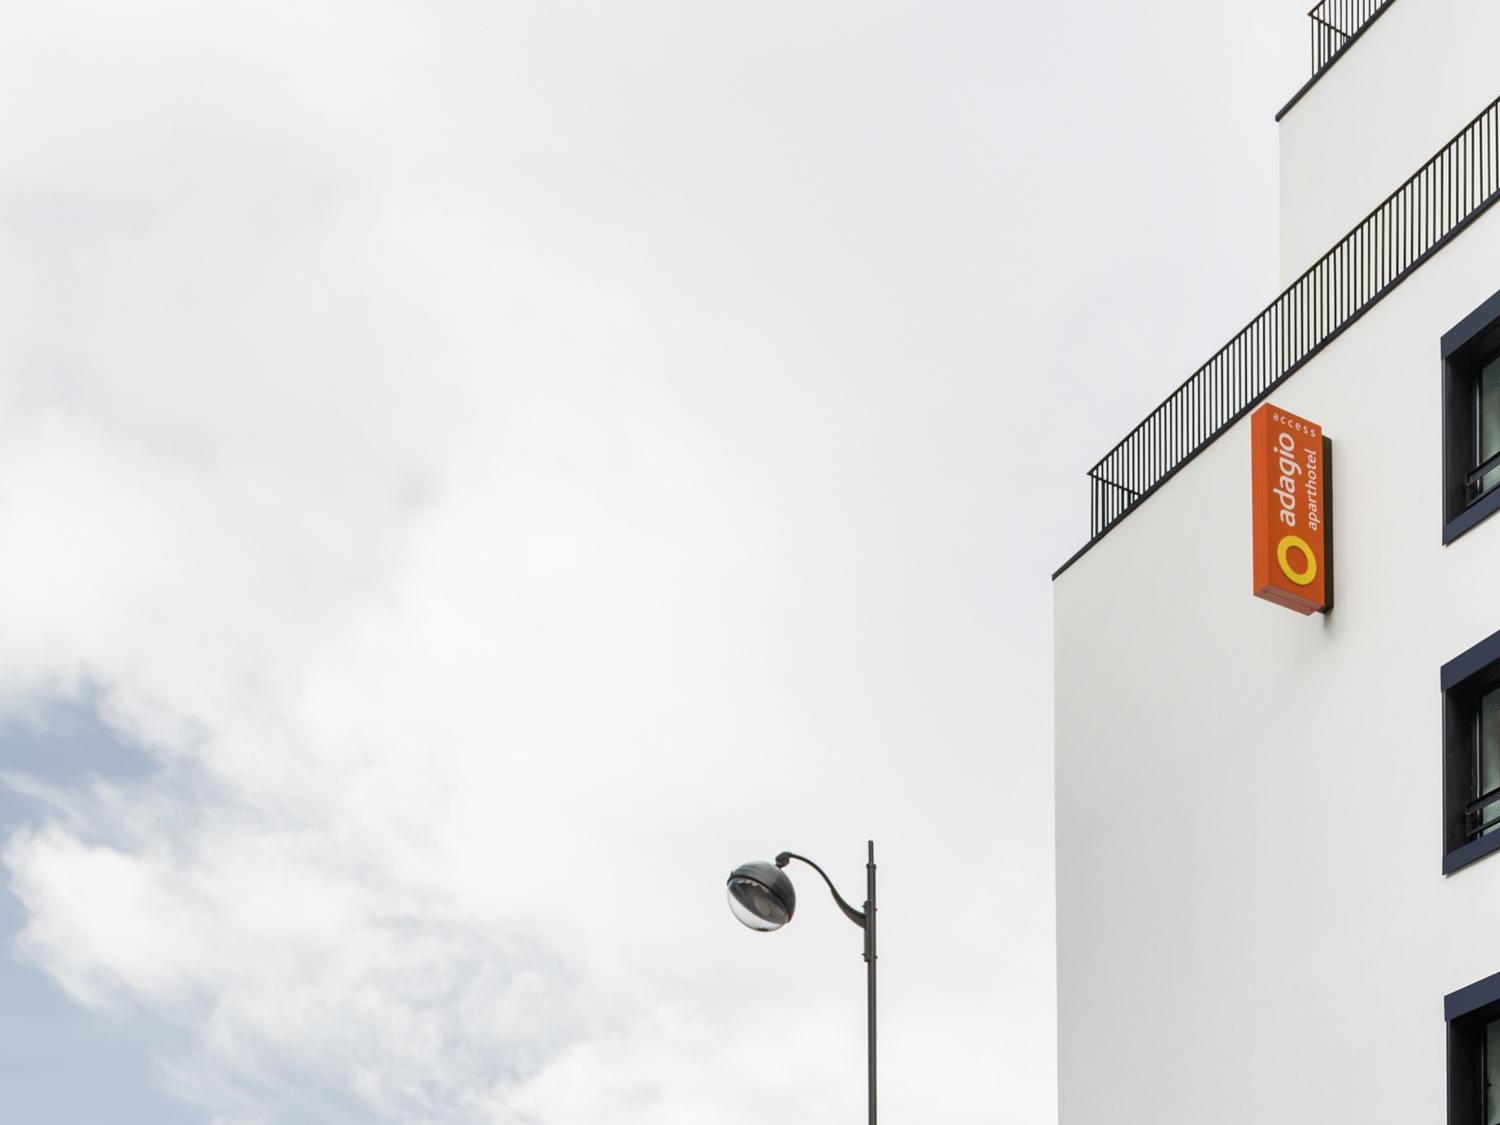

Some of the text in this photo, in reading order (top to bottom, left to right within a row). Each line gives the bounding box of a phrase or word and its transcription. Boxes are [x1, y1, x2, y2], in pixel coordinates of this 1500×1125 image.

[1273, 412, 1316, 438] access
[1273, 432, 1302, 527] adagio
[1304, 448, 1320, 531] aparthotel
